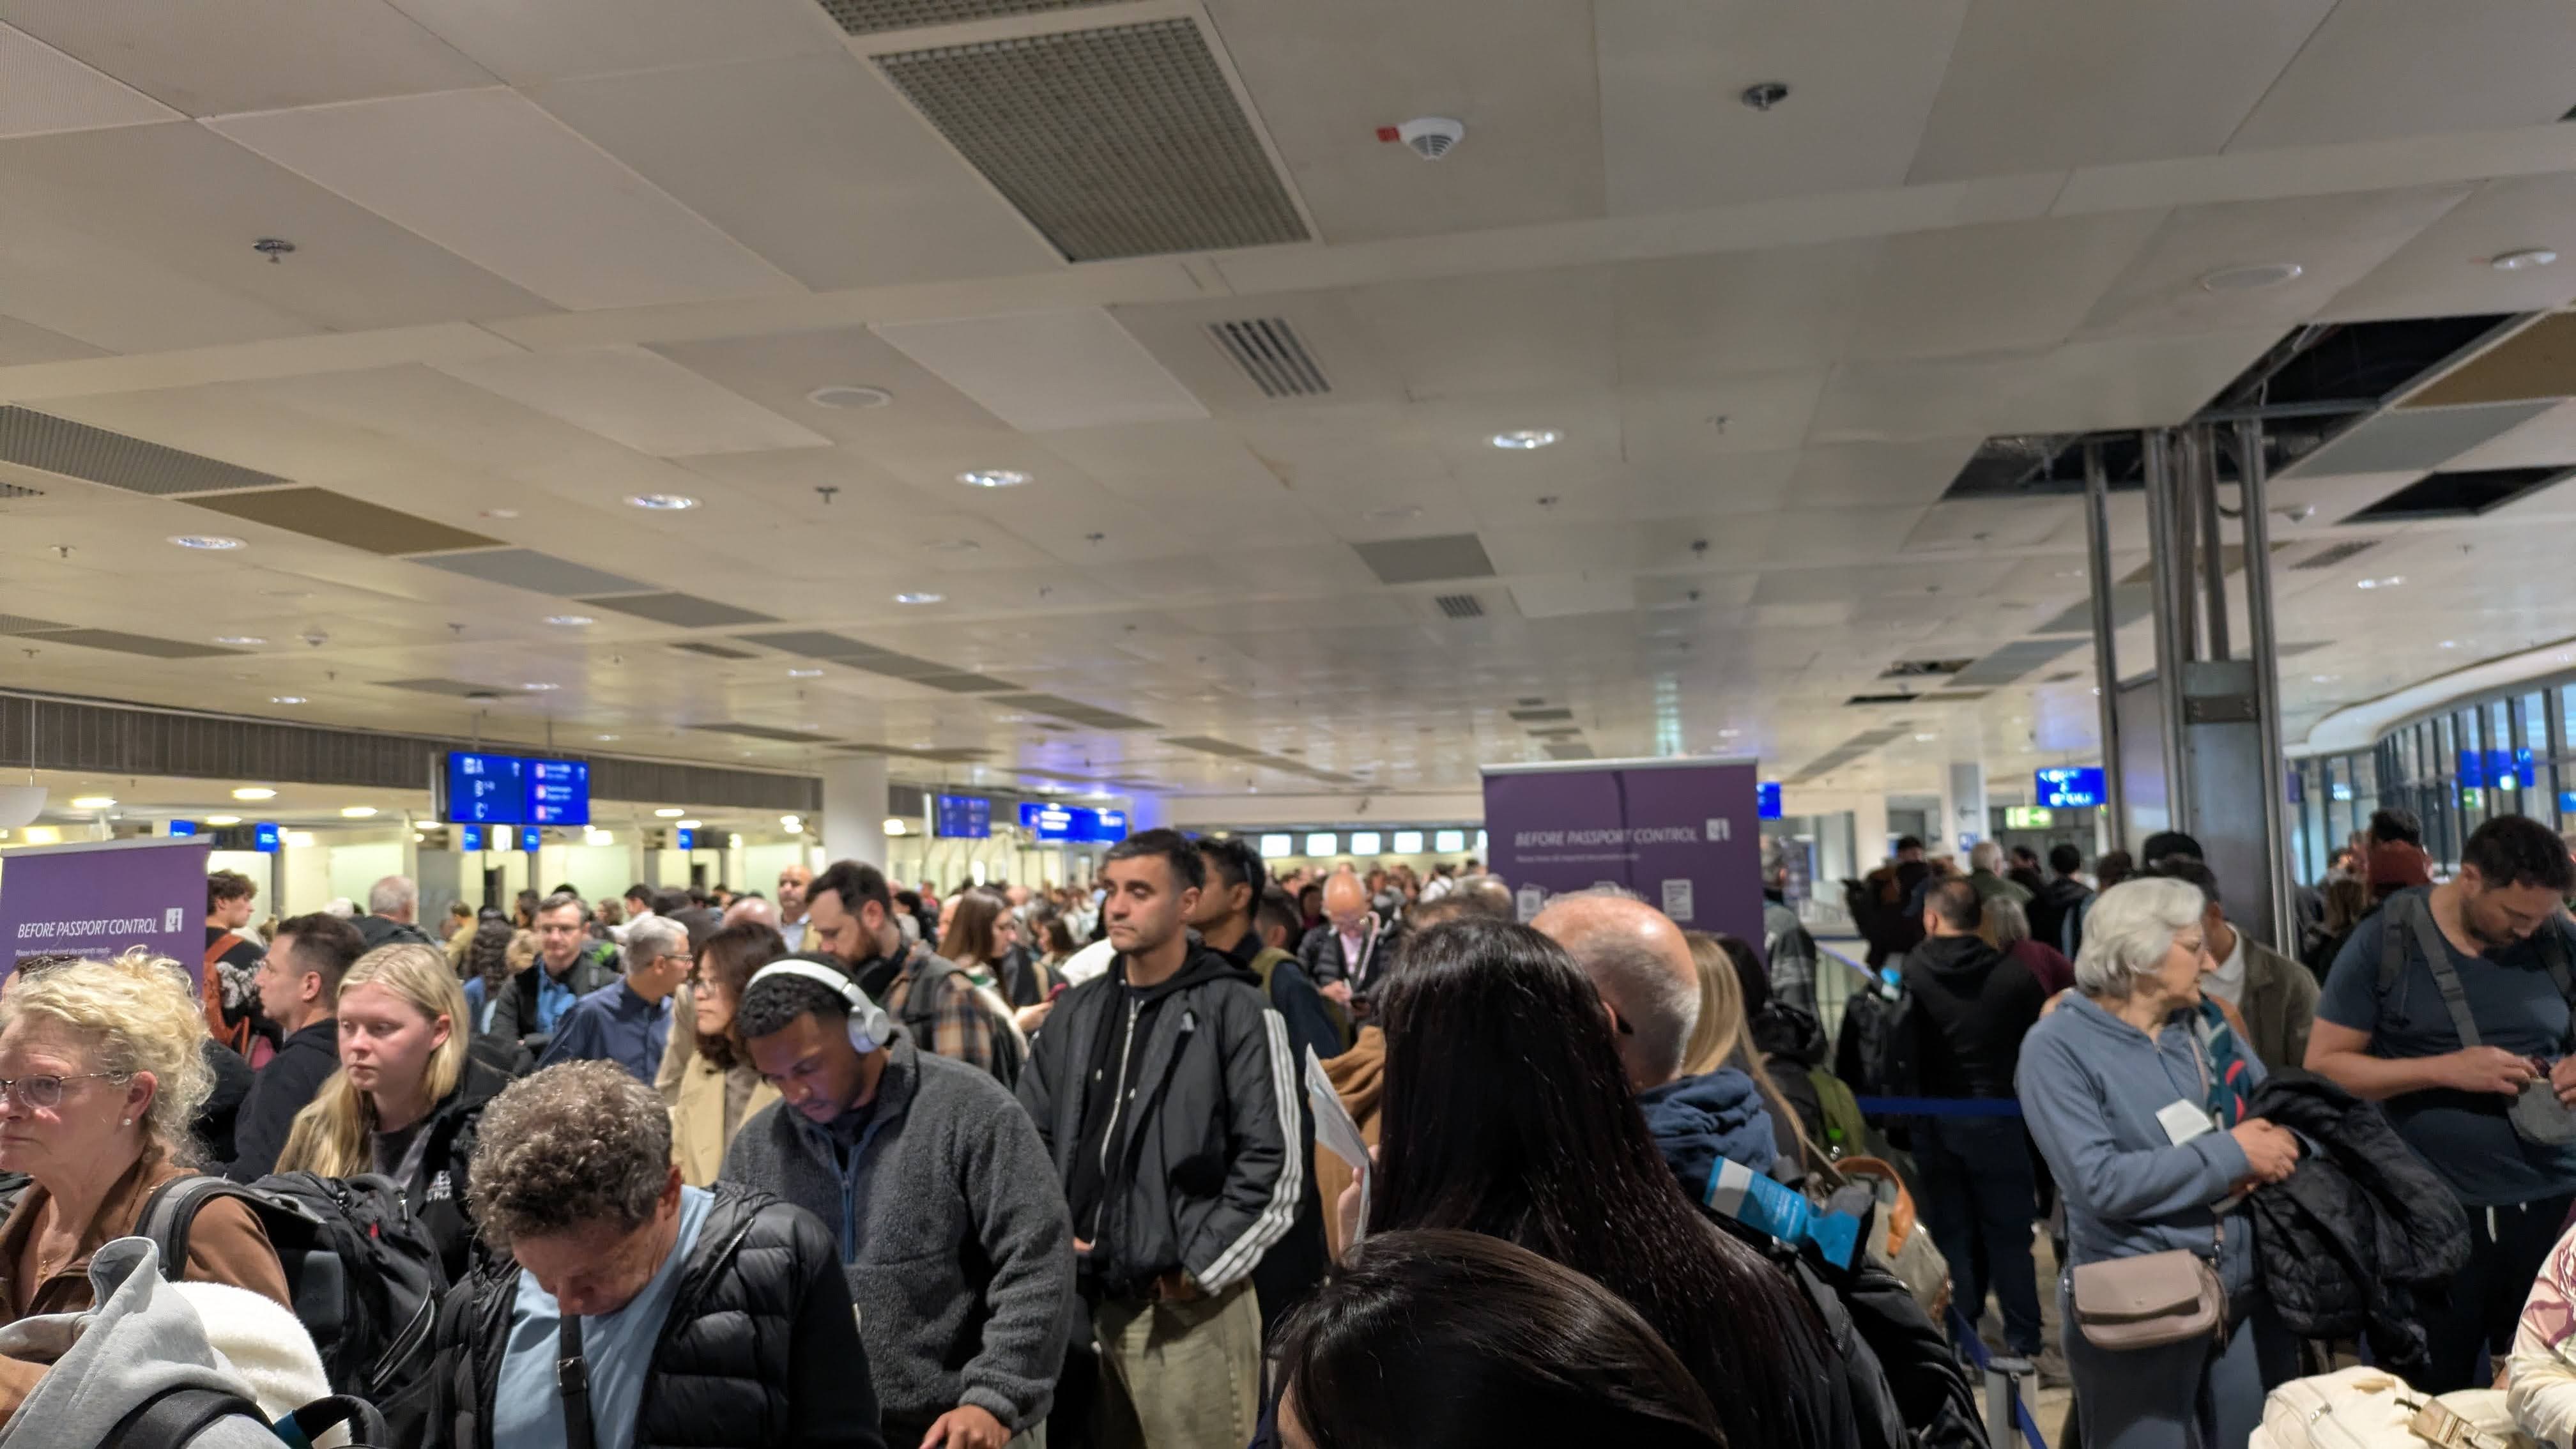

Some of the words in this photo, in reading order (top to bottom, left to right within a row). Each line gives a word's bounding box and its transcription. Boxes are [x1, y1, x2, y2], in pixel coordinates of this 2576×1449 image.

[1634, 827, 1698, 844] CONTROL
[18, 922, 56, 939] BEFORE
[56, 920, 110, 937] PASSPORT
[109, 917, 158, 935] CONTROL
